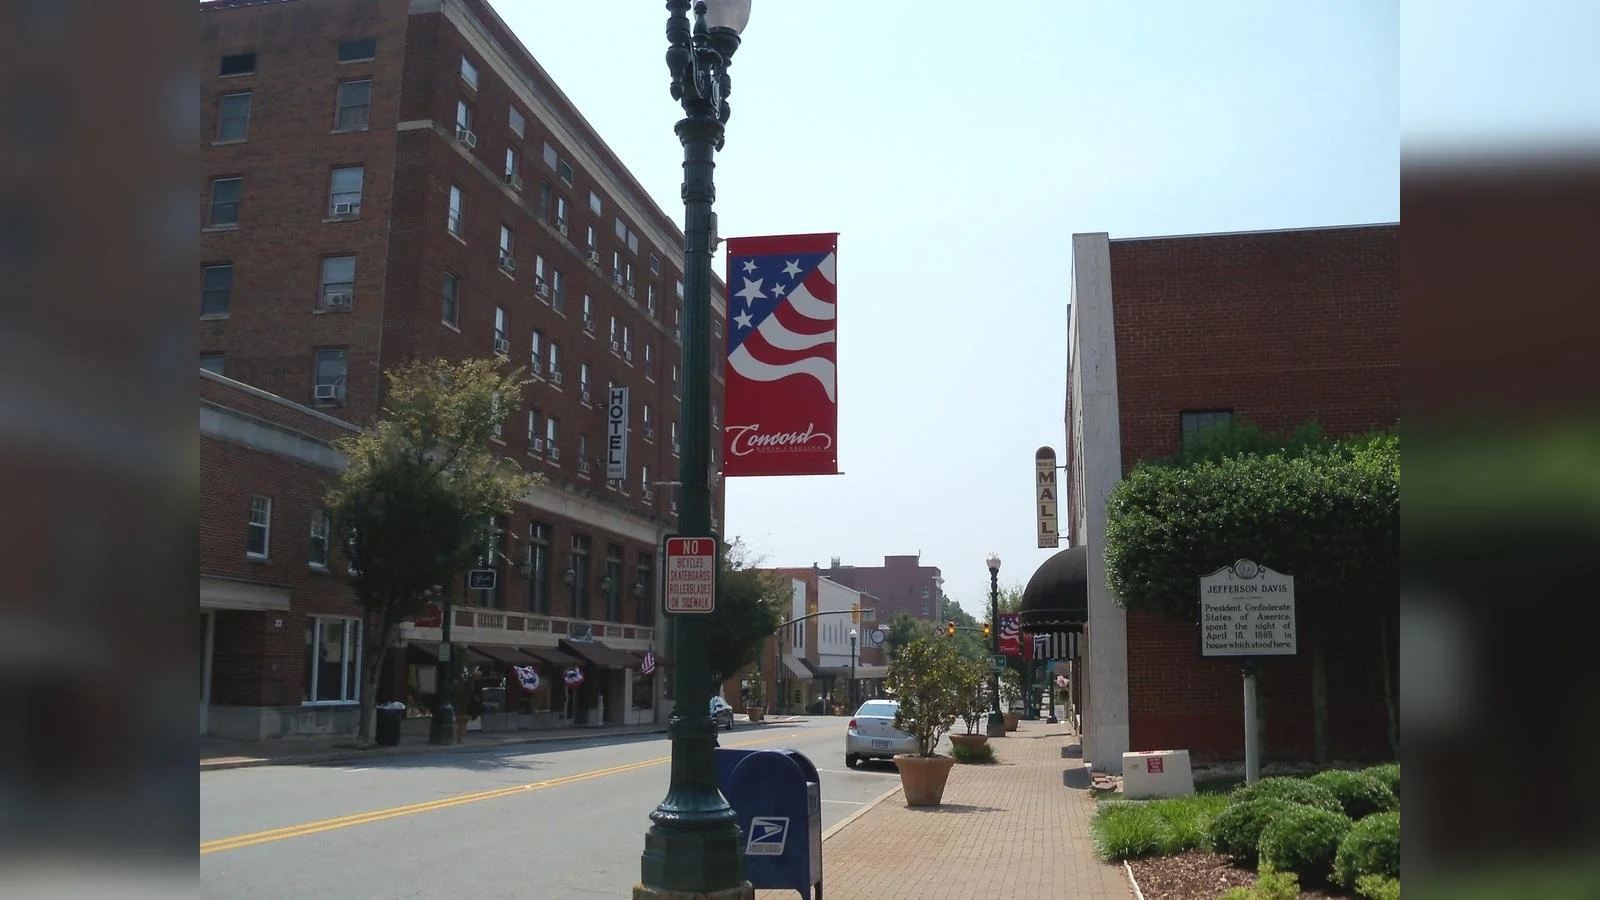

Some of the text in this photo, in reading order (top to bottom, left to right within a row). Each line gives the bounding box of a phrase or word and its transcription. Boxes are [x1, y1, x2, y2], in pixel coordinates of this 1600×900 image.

[609, 390, 624, 464] HOTEL
[725, 422, 832, 456] Concord
[1039, 471, 1055, 534] MALL
[683, 540, 699, 555] NO
[677, 557, 704, 569] BICYCLES
[670, 570, 711, 582] SKATEBOARDS
[669, 583, 711, 595] ROLLERBLADES
[1207, 584, 1288, 593] JEFFERSON DAVIS
[671, 597, 709, 609] ON SIDEWALK
[1245, 603, 1292, 612] Confederate
[1205, 613, 1232, 622] States
[1206, 623, 1227, 631] spent
[1235, 622, 1248, 630] the
[1255, 622, 1275, 631] night
[1206, 632, 1227, 641] April
[1228, 640, 1252, 649] which
[1252, 639, 1273, 648] stood
